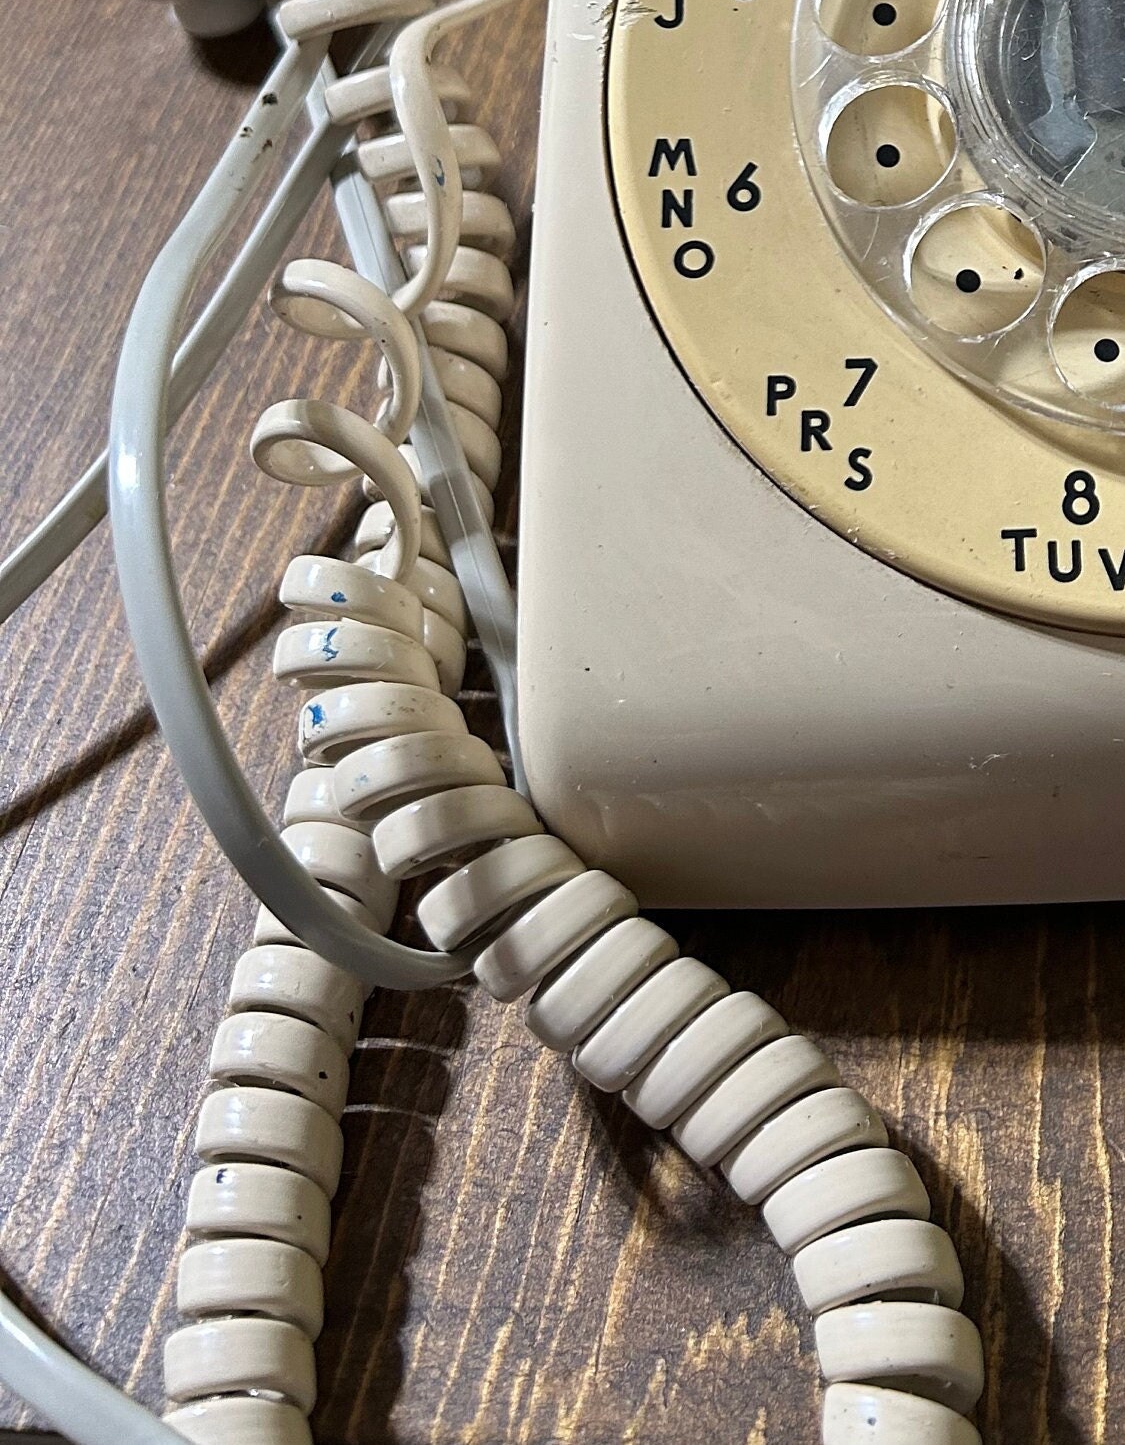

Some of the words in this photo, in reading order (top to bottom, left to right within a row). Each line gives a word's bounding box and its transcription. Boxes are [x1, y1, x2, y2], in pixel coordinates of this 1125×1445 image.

[648, 138, 715, 279] MNO
[726, 162, 761, 212] 6
[843, 358, 878, 407] 7
[766, 375, 873, 492] PRS
[1061, 470, 1100, 526] 8
